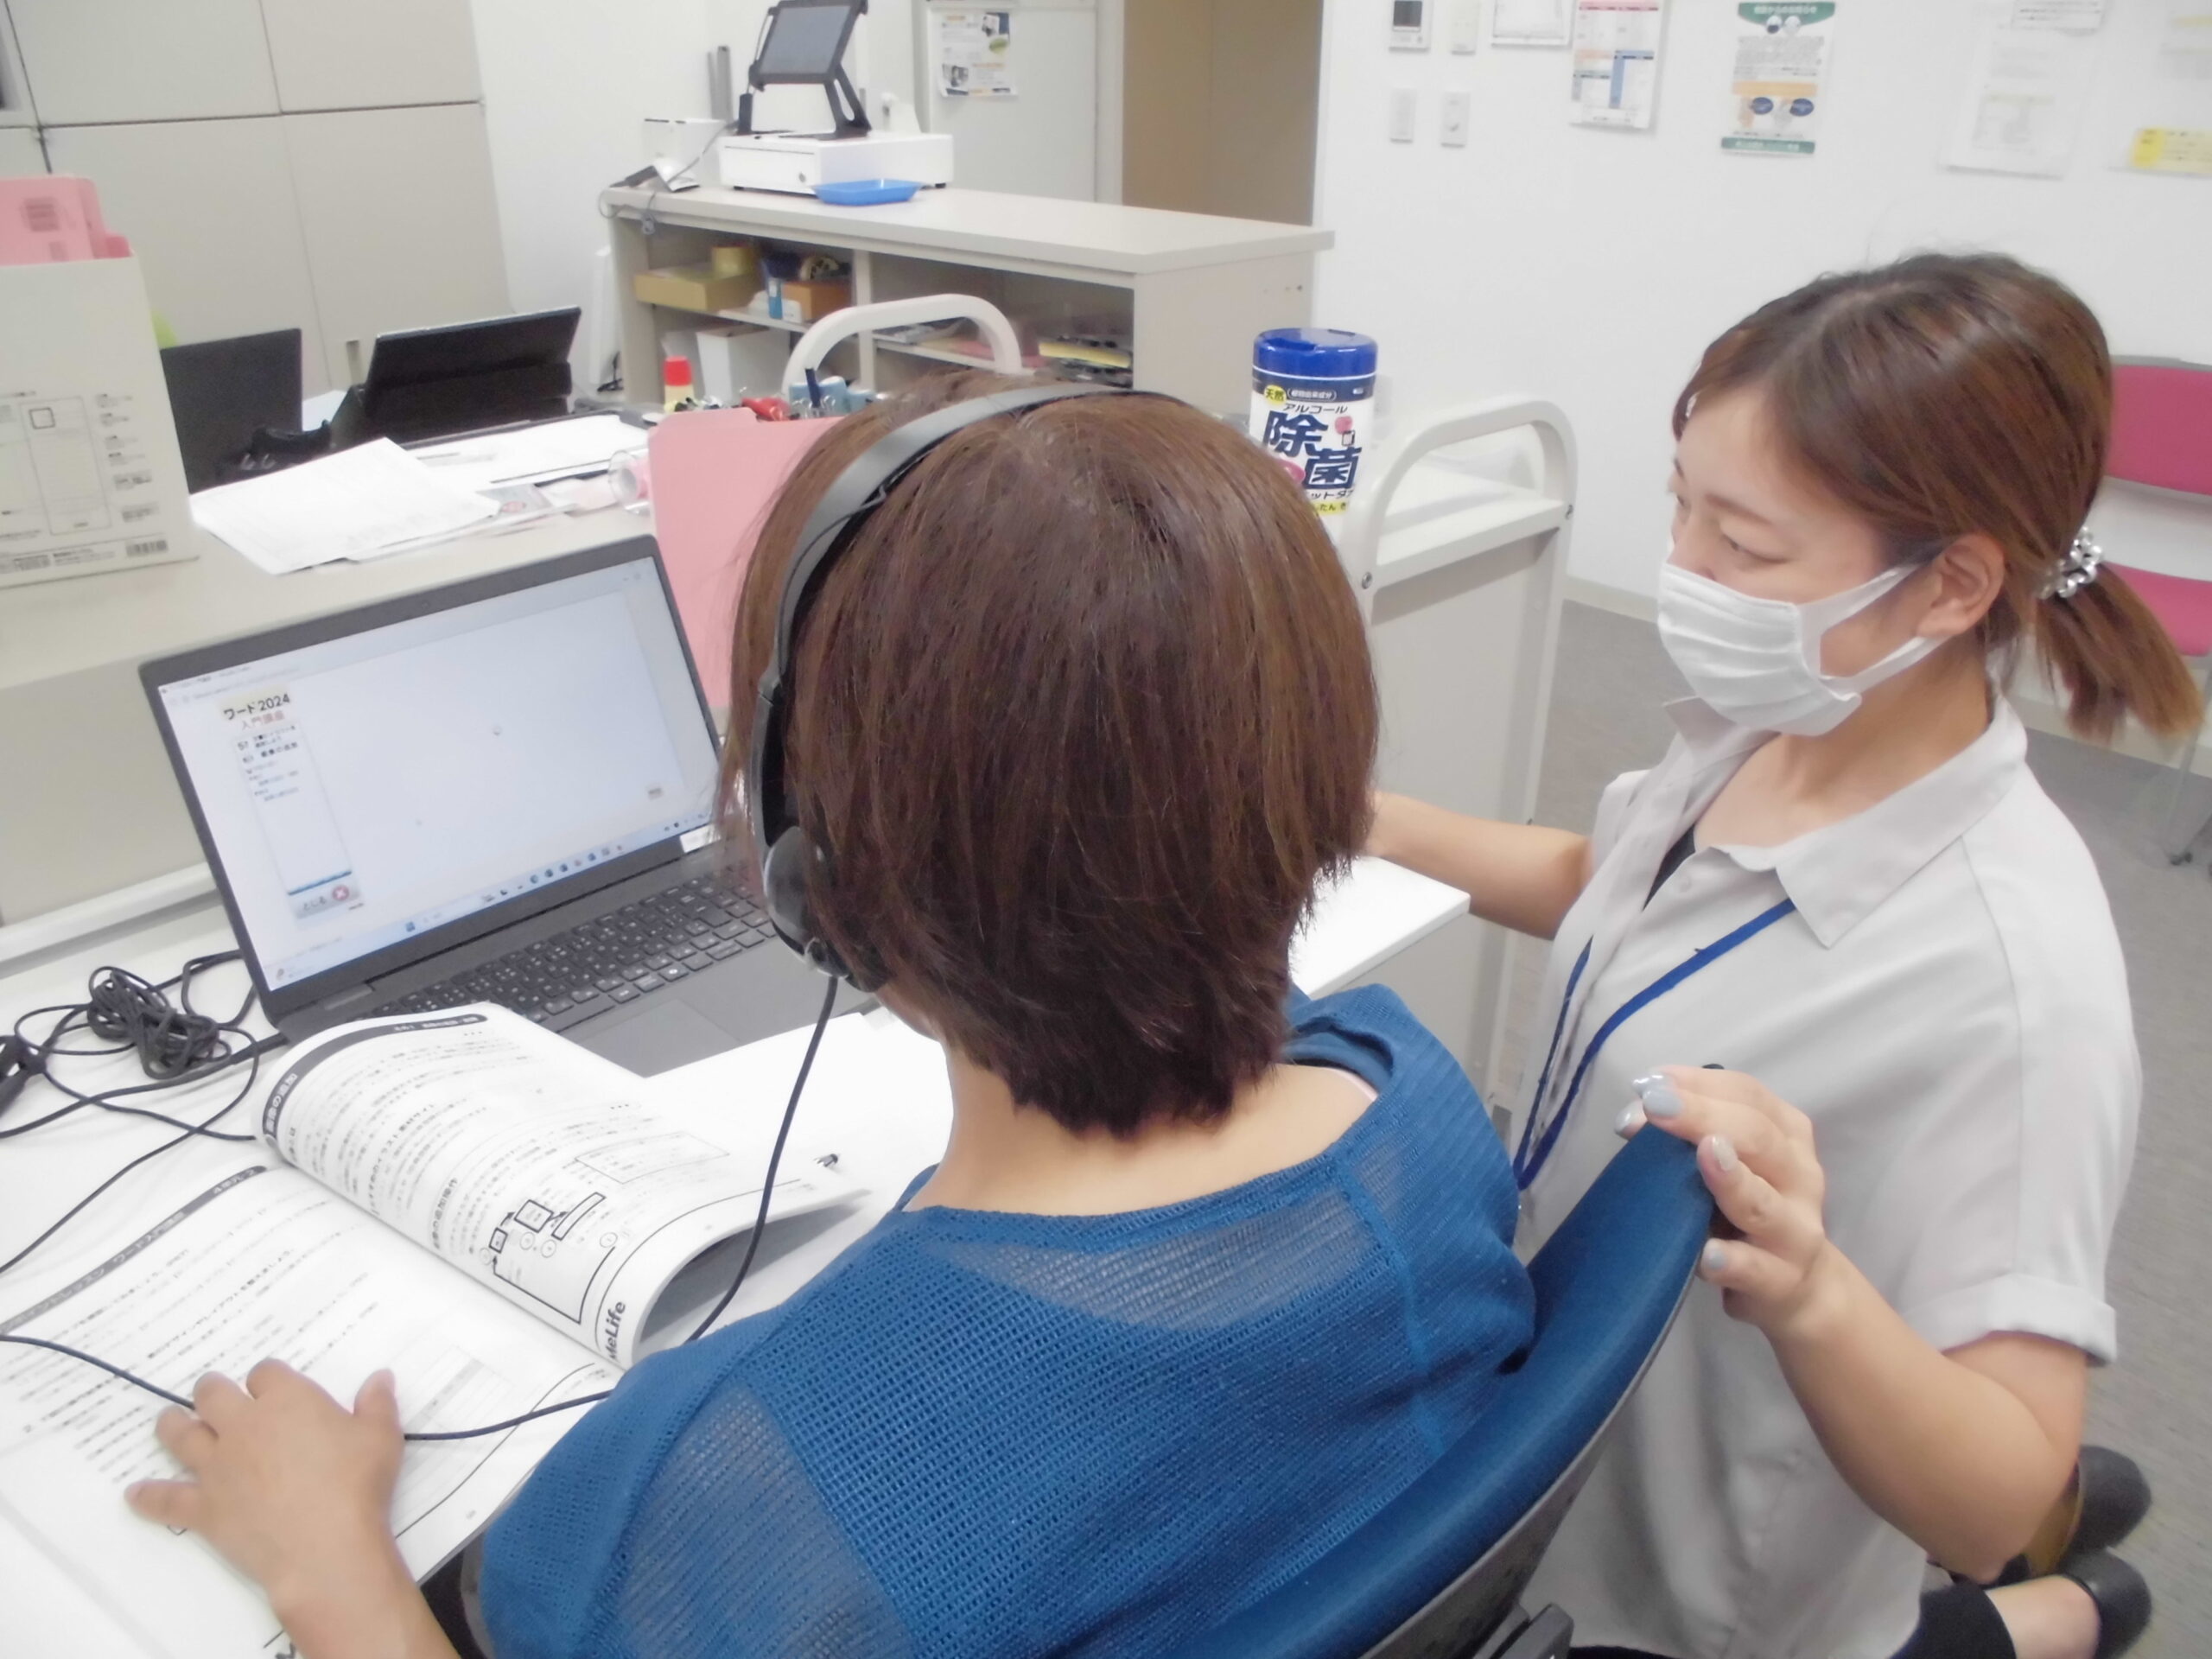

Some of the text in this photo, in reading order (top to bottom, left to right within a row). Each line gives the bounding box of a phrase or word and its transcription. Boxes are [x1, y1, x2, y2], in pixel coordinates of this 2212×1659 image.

[1265, 388, 1284, 401] 天然
[1283, 403, 1348, 414] アルコール
[1262, 410, 1363, 490] 除菌
[223, 693, 290, 721] ワード2024
